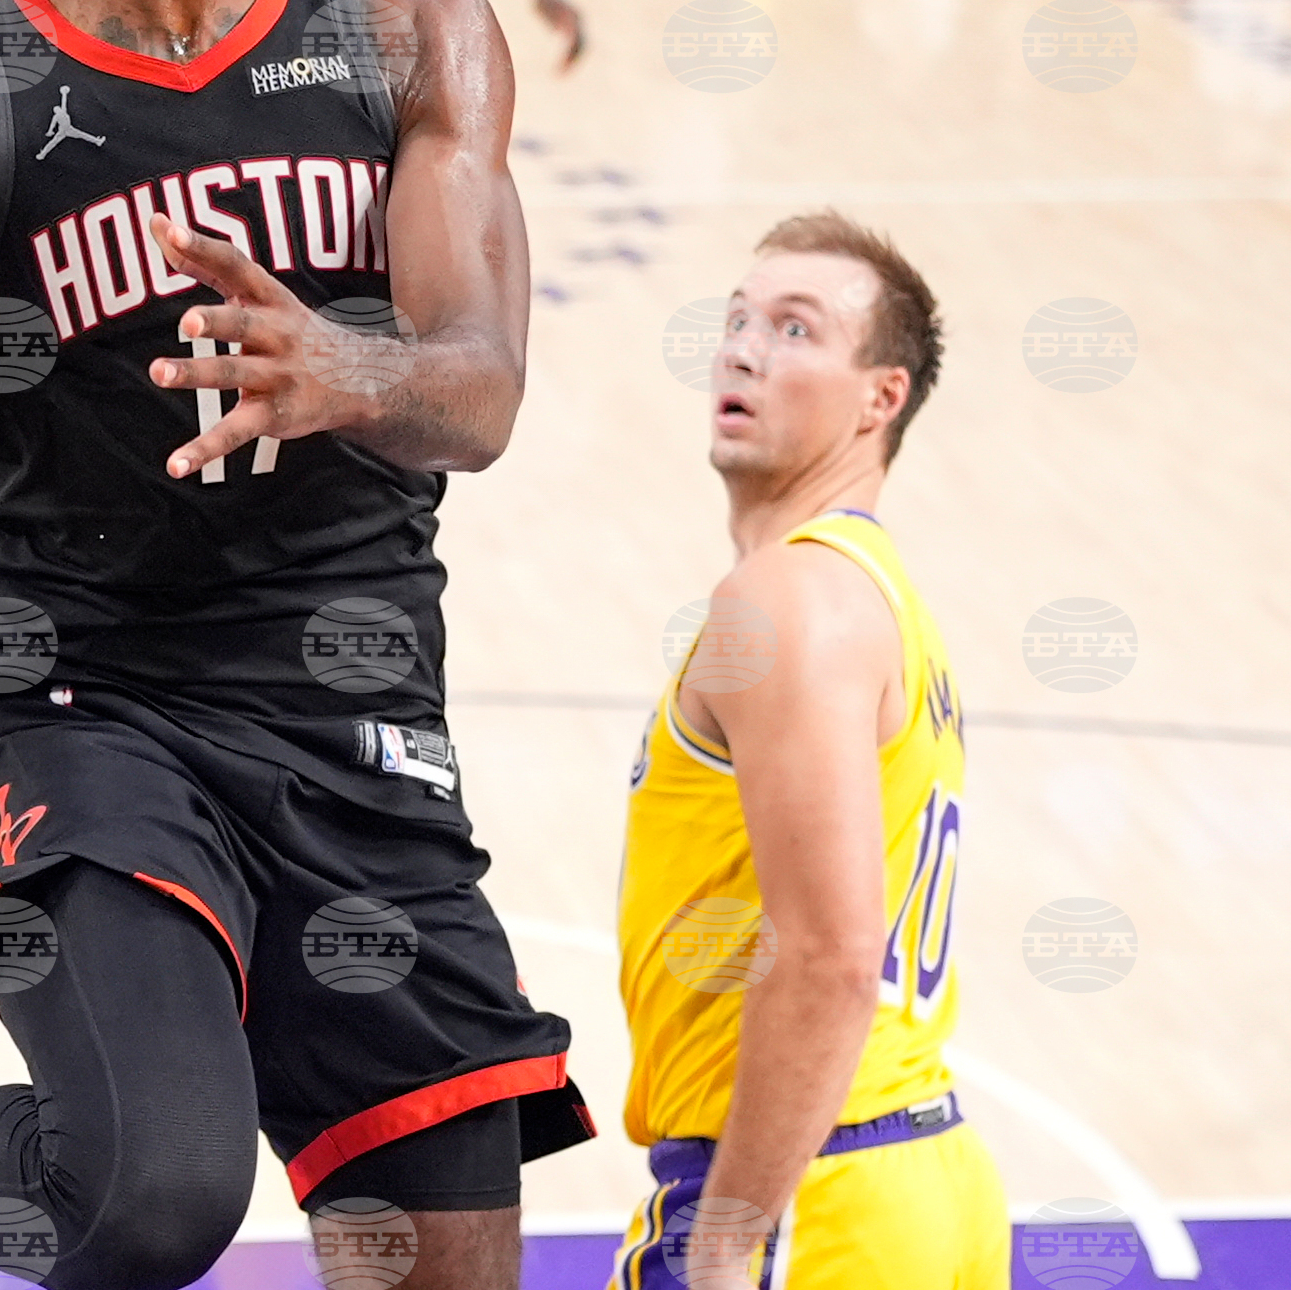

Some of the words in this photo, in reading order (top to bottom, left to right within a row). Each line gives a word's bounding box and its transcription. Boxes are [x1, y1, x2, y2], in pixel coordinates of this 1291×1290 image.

[250, 54, 350, 81] MEMORIAL
[252, 65, 351, 95] HERMANN
[30, 155, 389, 343] HOUSTON
[881, 784, 961, 1020] 10
